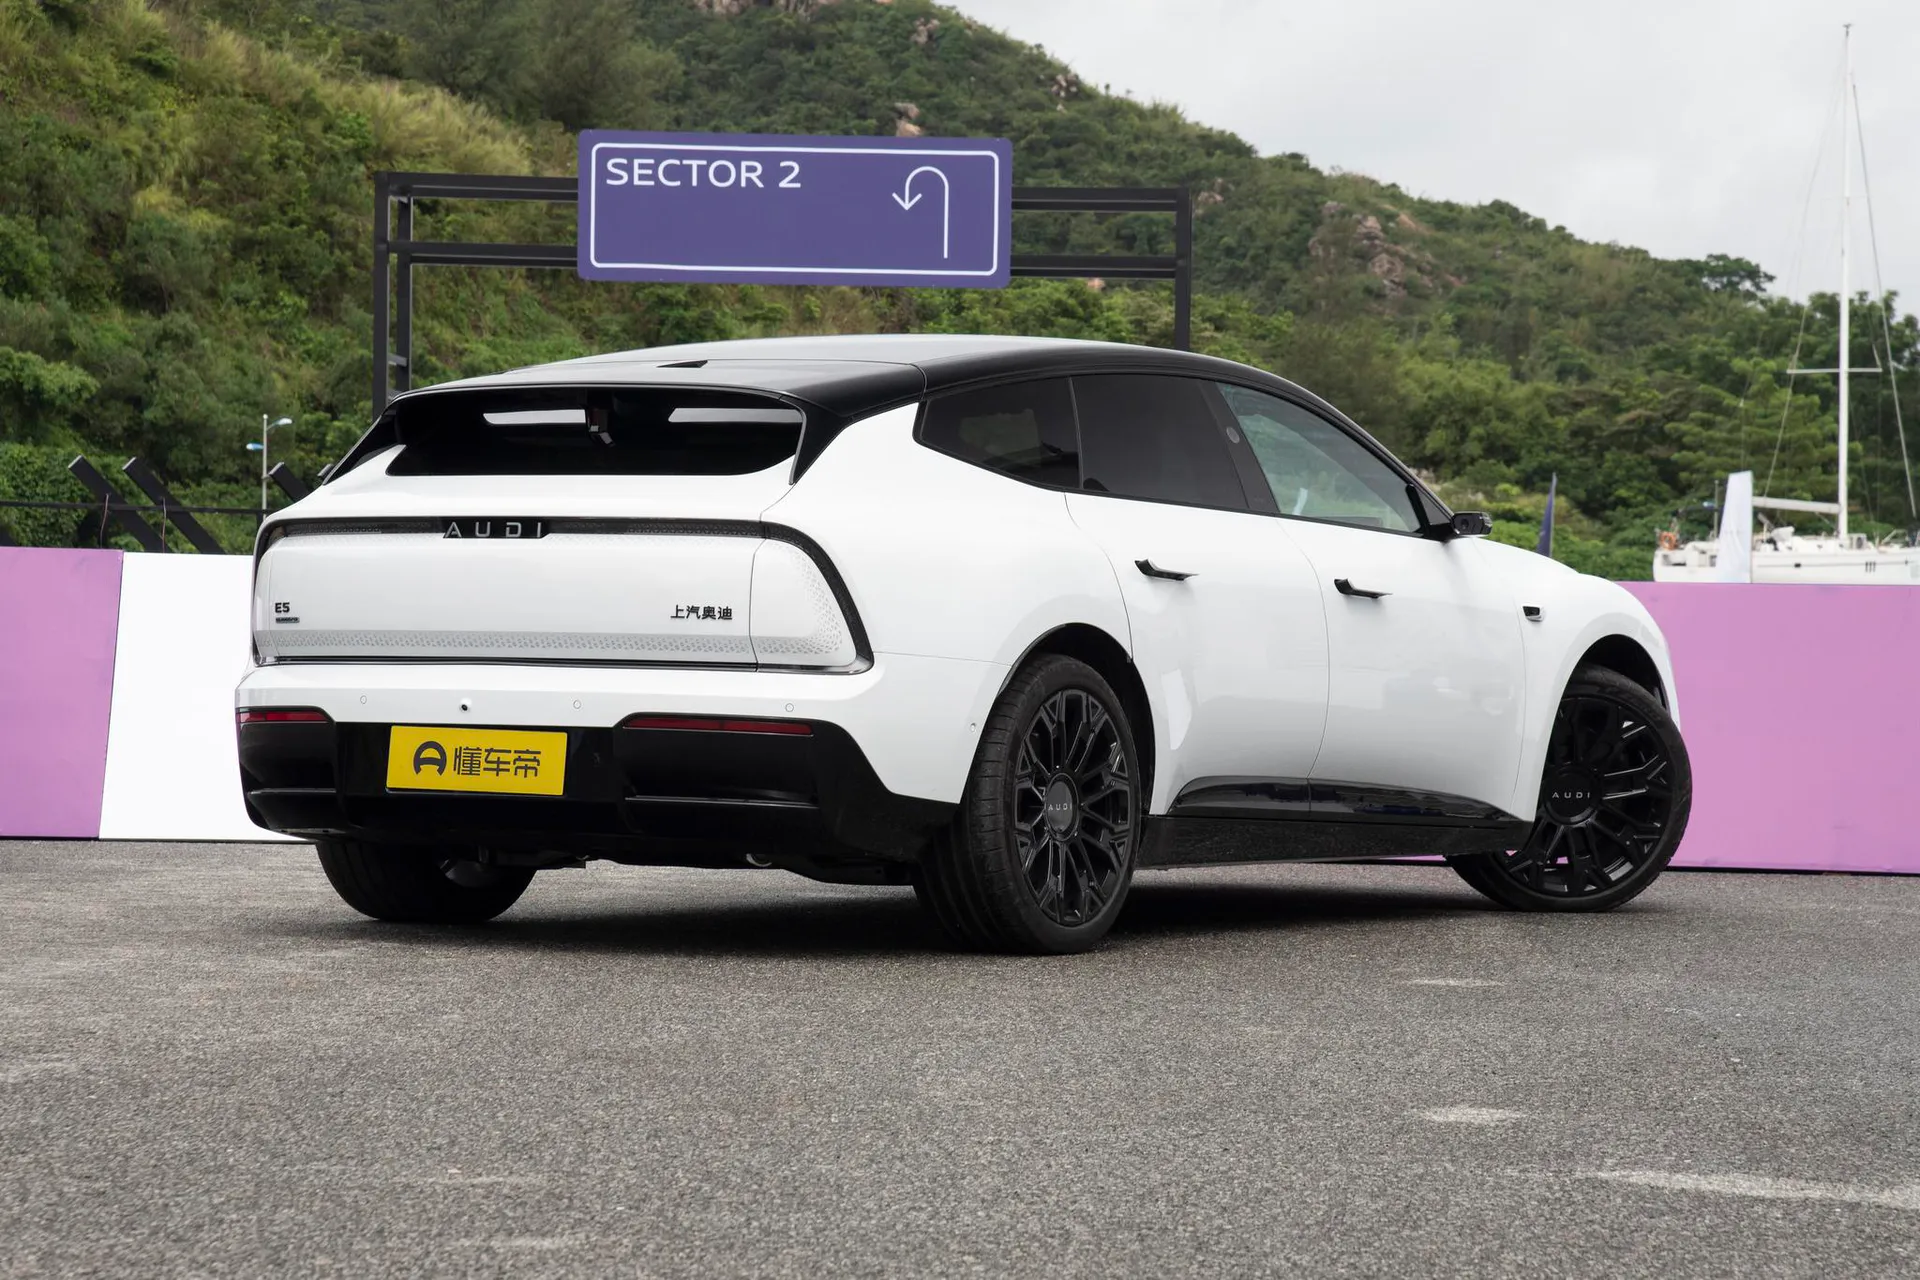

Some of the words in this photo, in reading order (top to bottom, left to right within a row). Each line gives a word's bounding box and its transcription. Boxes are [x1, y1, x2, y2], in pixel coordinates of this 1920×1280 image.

[606, 158, 764, 188] SECTOR
[779, 161, 801, 188] 2
[445, 521, 542, 538] AUDI
[275, 602, 290, 613] E5
[670, 604, 733, 620] 上汽奥迪
[453, 746, 541, 778] 懂车帝
[1048, 803, 1072, 811] AUDI
